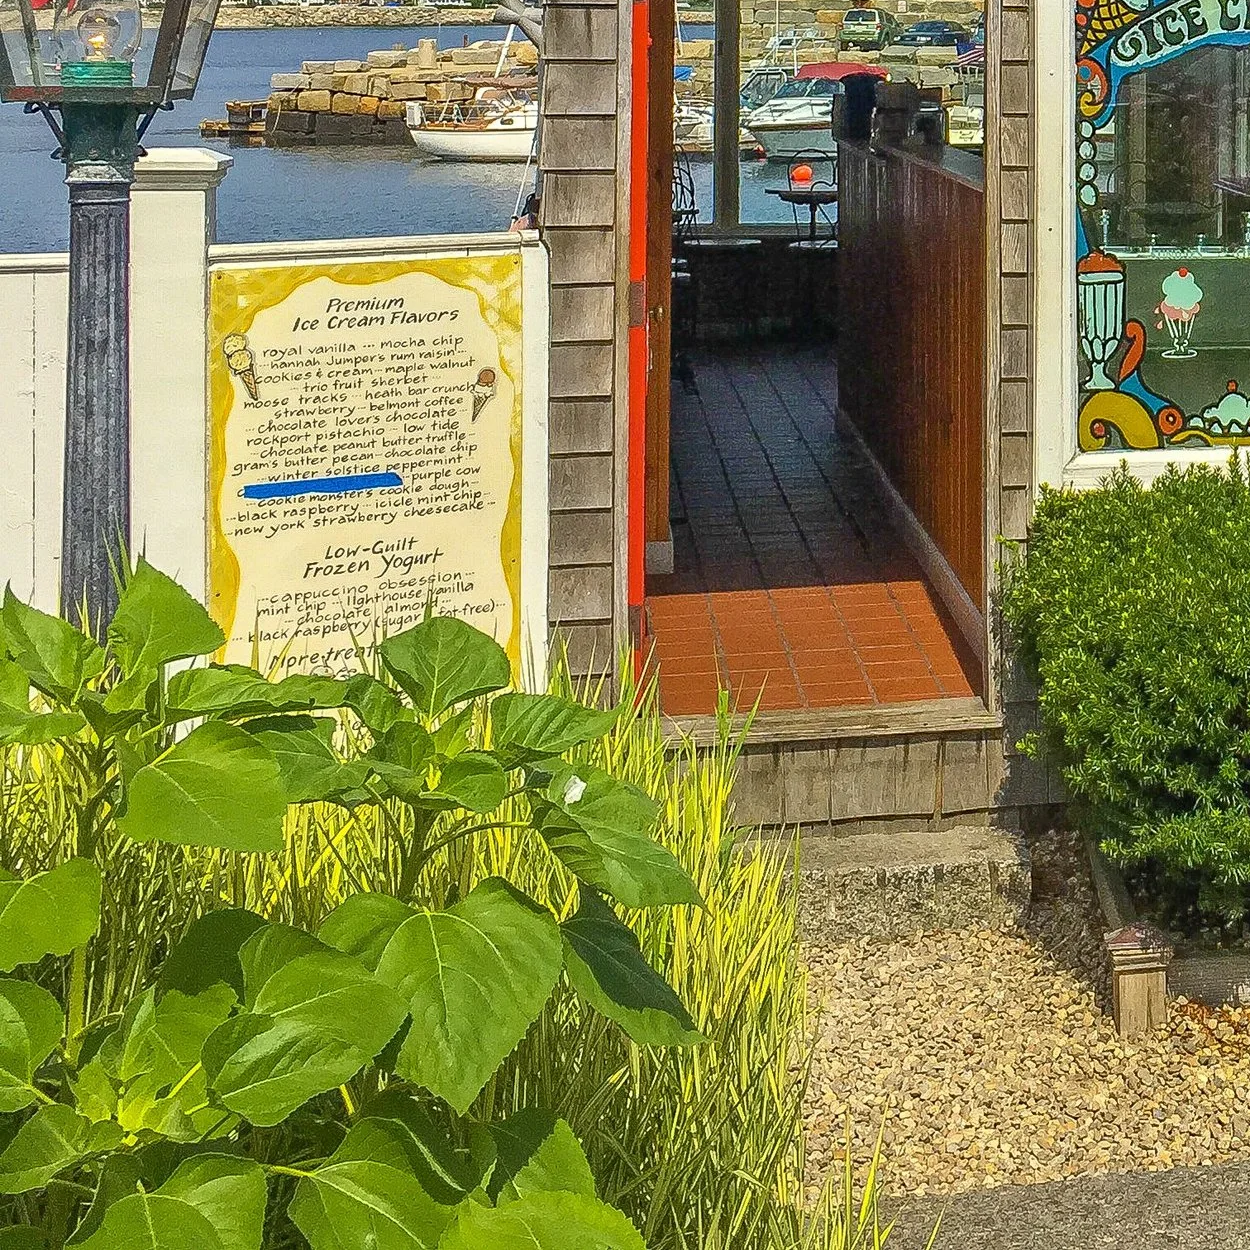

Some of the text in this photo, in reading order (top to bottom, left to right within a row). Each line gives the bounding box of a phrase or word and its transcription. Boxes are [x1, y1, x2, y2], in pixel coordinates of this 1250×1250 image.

[1138, 0, 1209, 57] ICE
[326, 297, 404, 313] Premium
[293, 308, 459, 332] Ice Cream Flavors
[263, 334, 464, 361] royal vanilla mocha chip
[271, 358, 320, 370] hannah
[390, 352, 415, 361] rum
[418, 347, 456, 359] raisin
[327, 367, 373, 378] cream
[385, 362, 425, 378] maple
[430, 357, 476, 370] walnut
[244, 381, 476, 409] moose tracks heath bar crunch
[304, 372, 428, 393] trio fruit sherbet
[257, 408, 457, 434] chocolate lover's chocolate
[274, 396, 464, 419] strawberry belmont coffee
[246, 419, 459, 448] rockport pistachio low tide
[260, 430, 467, 459] chocolate peanut butter truffle
[231, 458, 278, 477] gram's
[284, 454, 327, 467] butter
[450, 441, 478, 456] chip
[268, 454, 463, 482] winter solstice peppermint
[412, 466, 481, 485] purple cow
[238, 489, 482, 522] black raspberry icicle mint chip
[257, 494, 306, 508] cookie
[380, 484, 423, 496] cookie
[429, 479, 469, 493] dough
[234, 499, 484, 539] new york strawberry cheesecake
[325, 537, 418, 560] Low-Guilt
[303, 547, 444, 579] Frozen Yogurt
[257, 581, 474, 618] mint chip lighthouse vanilla
[270, 572, 462, 605] cappuccino obsession
[294, 619, 372, 639] raspberry
[297, 608, 371, 626] chocolate
[326, 641, 381, 662] treat
